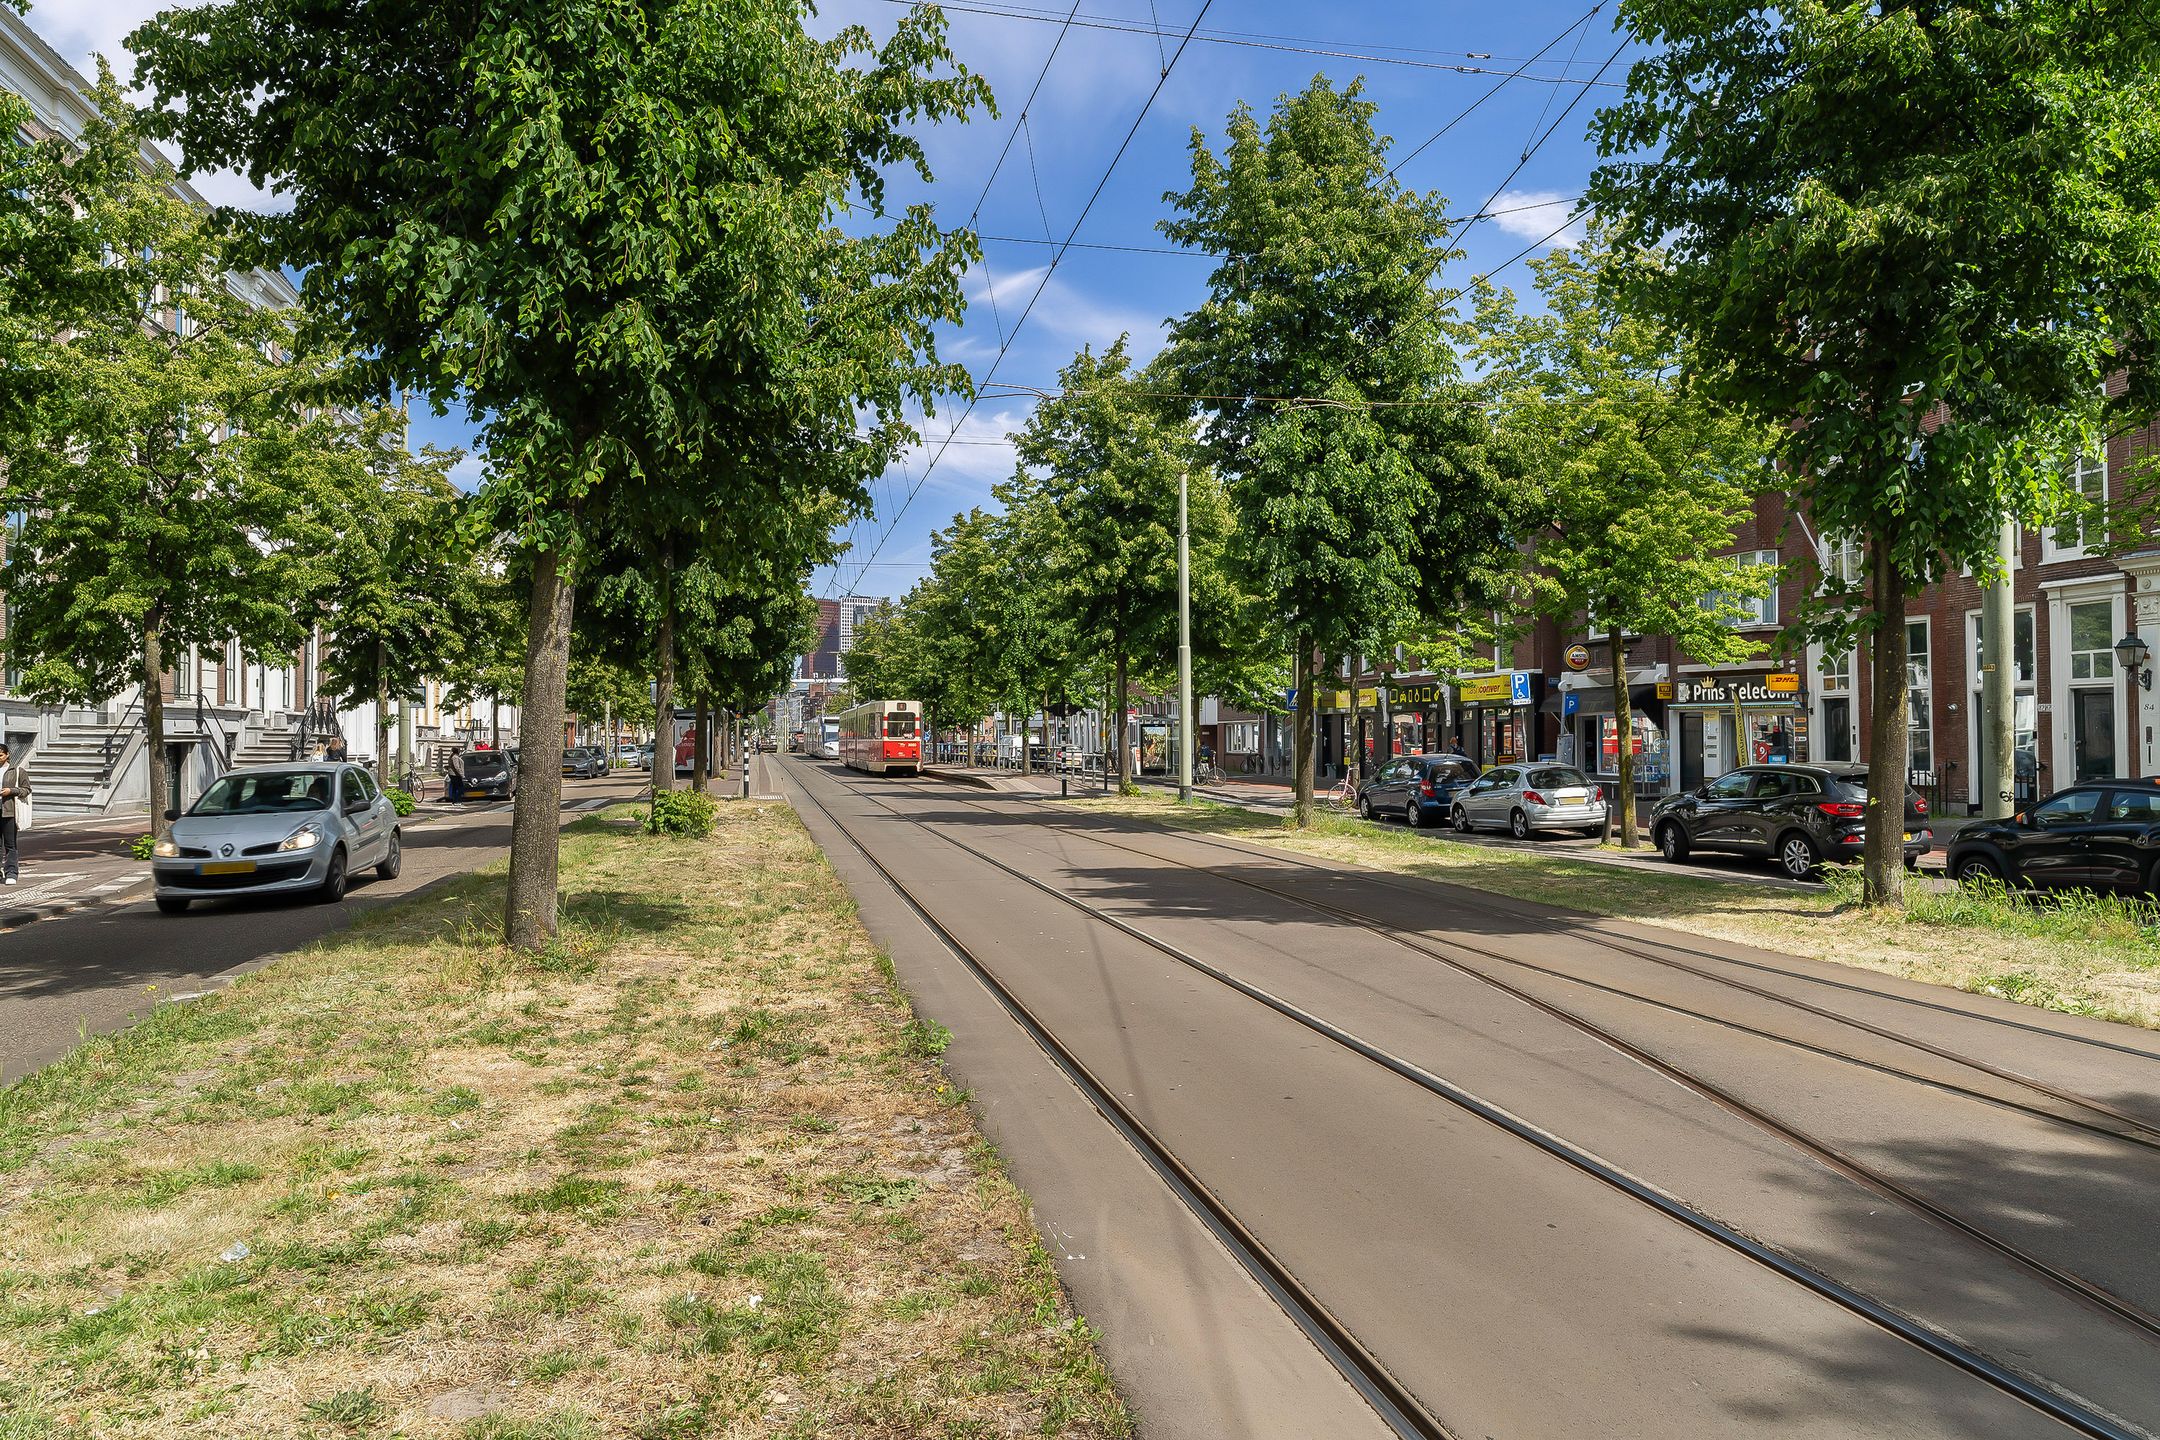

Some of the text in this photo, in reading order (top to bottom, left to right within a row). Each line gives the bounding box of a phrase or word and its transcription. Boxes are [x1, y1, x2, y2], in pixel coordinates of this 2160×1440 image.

[1515, 675, 1525, 689] P
[1693, 685, 1725, 701] Prins
[1568, 700, 1575, 709] P
